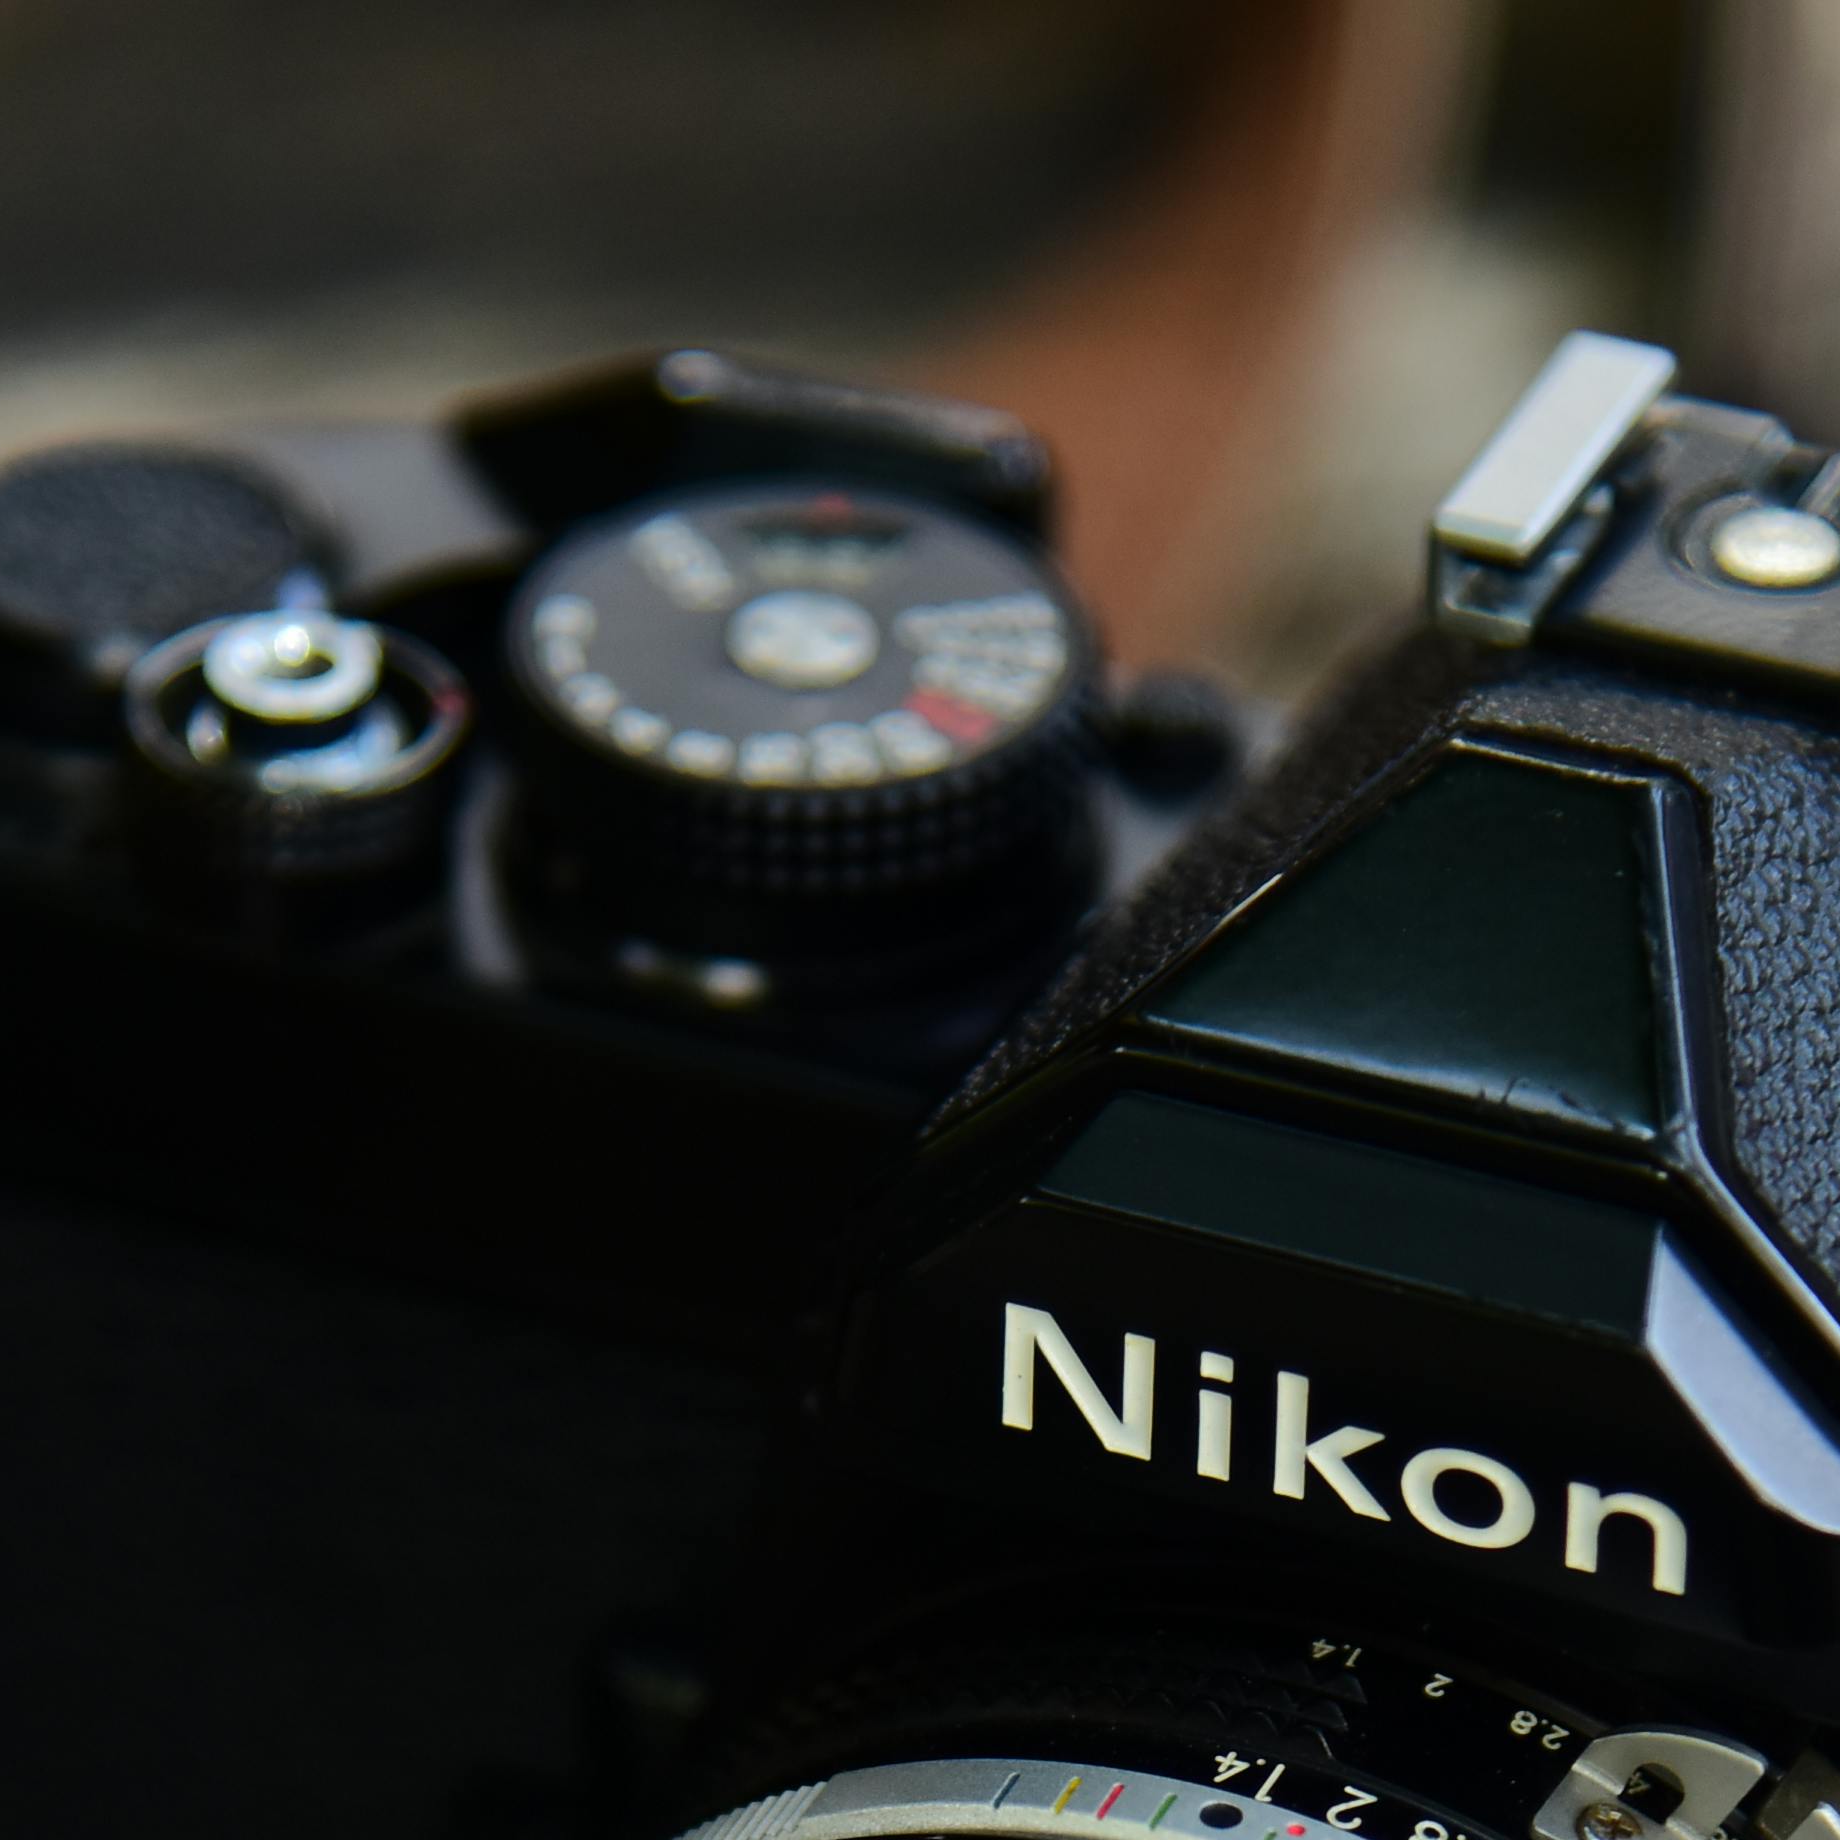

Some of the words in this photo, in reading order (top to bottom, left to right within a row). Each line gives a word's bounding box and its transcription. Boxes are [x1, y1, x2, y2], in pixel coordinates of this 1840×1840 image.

[1000, 1300, 1688, 1597] Nikon
[1310, 1638, 1363, 1668] 1.4
[1423, 1672, 1455, 1699] 2
[1509, 1707, 1573, 1751] 2.8
[1212, 1751, 1287, 1802] 1.4
[1324, 1784, 1378, 1830] 2
